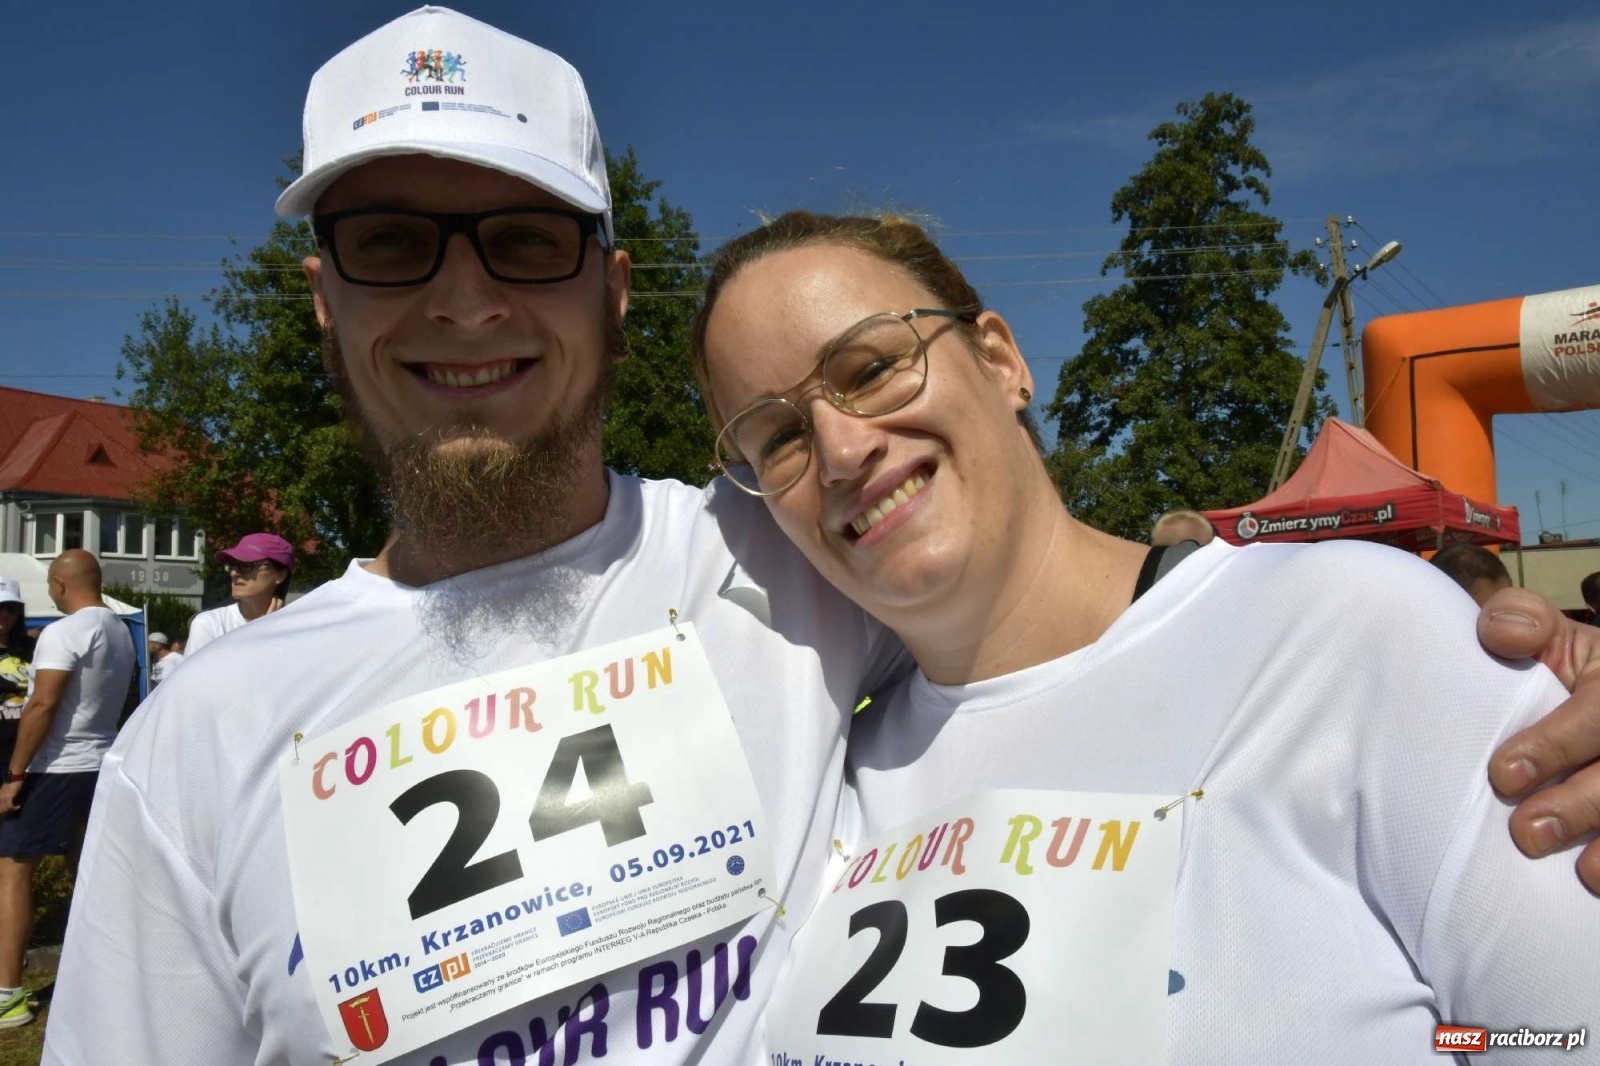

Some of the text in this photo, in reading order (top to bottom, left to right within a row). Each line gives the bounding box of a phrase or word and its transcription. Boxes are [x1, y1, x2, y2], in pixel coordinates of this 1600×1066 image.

[405, 85, 465, 97] COLOUR RUN
[312, 646, 674, 800] COLOUR RUN
[388, 723, 655, 920] 24
[831, 814, 1141, 894] COLOUR RUN
[328, 820, 757, 994] 10km, Krzanowice, 05.09.2021
[401, 1007, 424, 1022] Projekt
[425, 1002, 437, 1014] jest
[496, 974, 505, 982] ze
[535, 944, 584, 966] Europejskiego
[584, 932, 618, 948] Funduszu
[618, 922, 647, 937] Rozwoju
[647, 906, 691, 926] Regionalnego
[691, 901, 706, 911] oraz
[533, 962, 559, 977] ramach
[560, 951, 593, 968] programu
[594, 936, 632, 954] INTERREG
[632, 932, 646, 940] V-A
[646, 921, 678, 935] Republika
[679, 911, 703, 924] Czeska
[706, 903, 727, 915] Polska
[816, 888, 1031, 1048] 23
